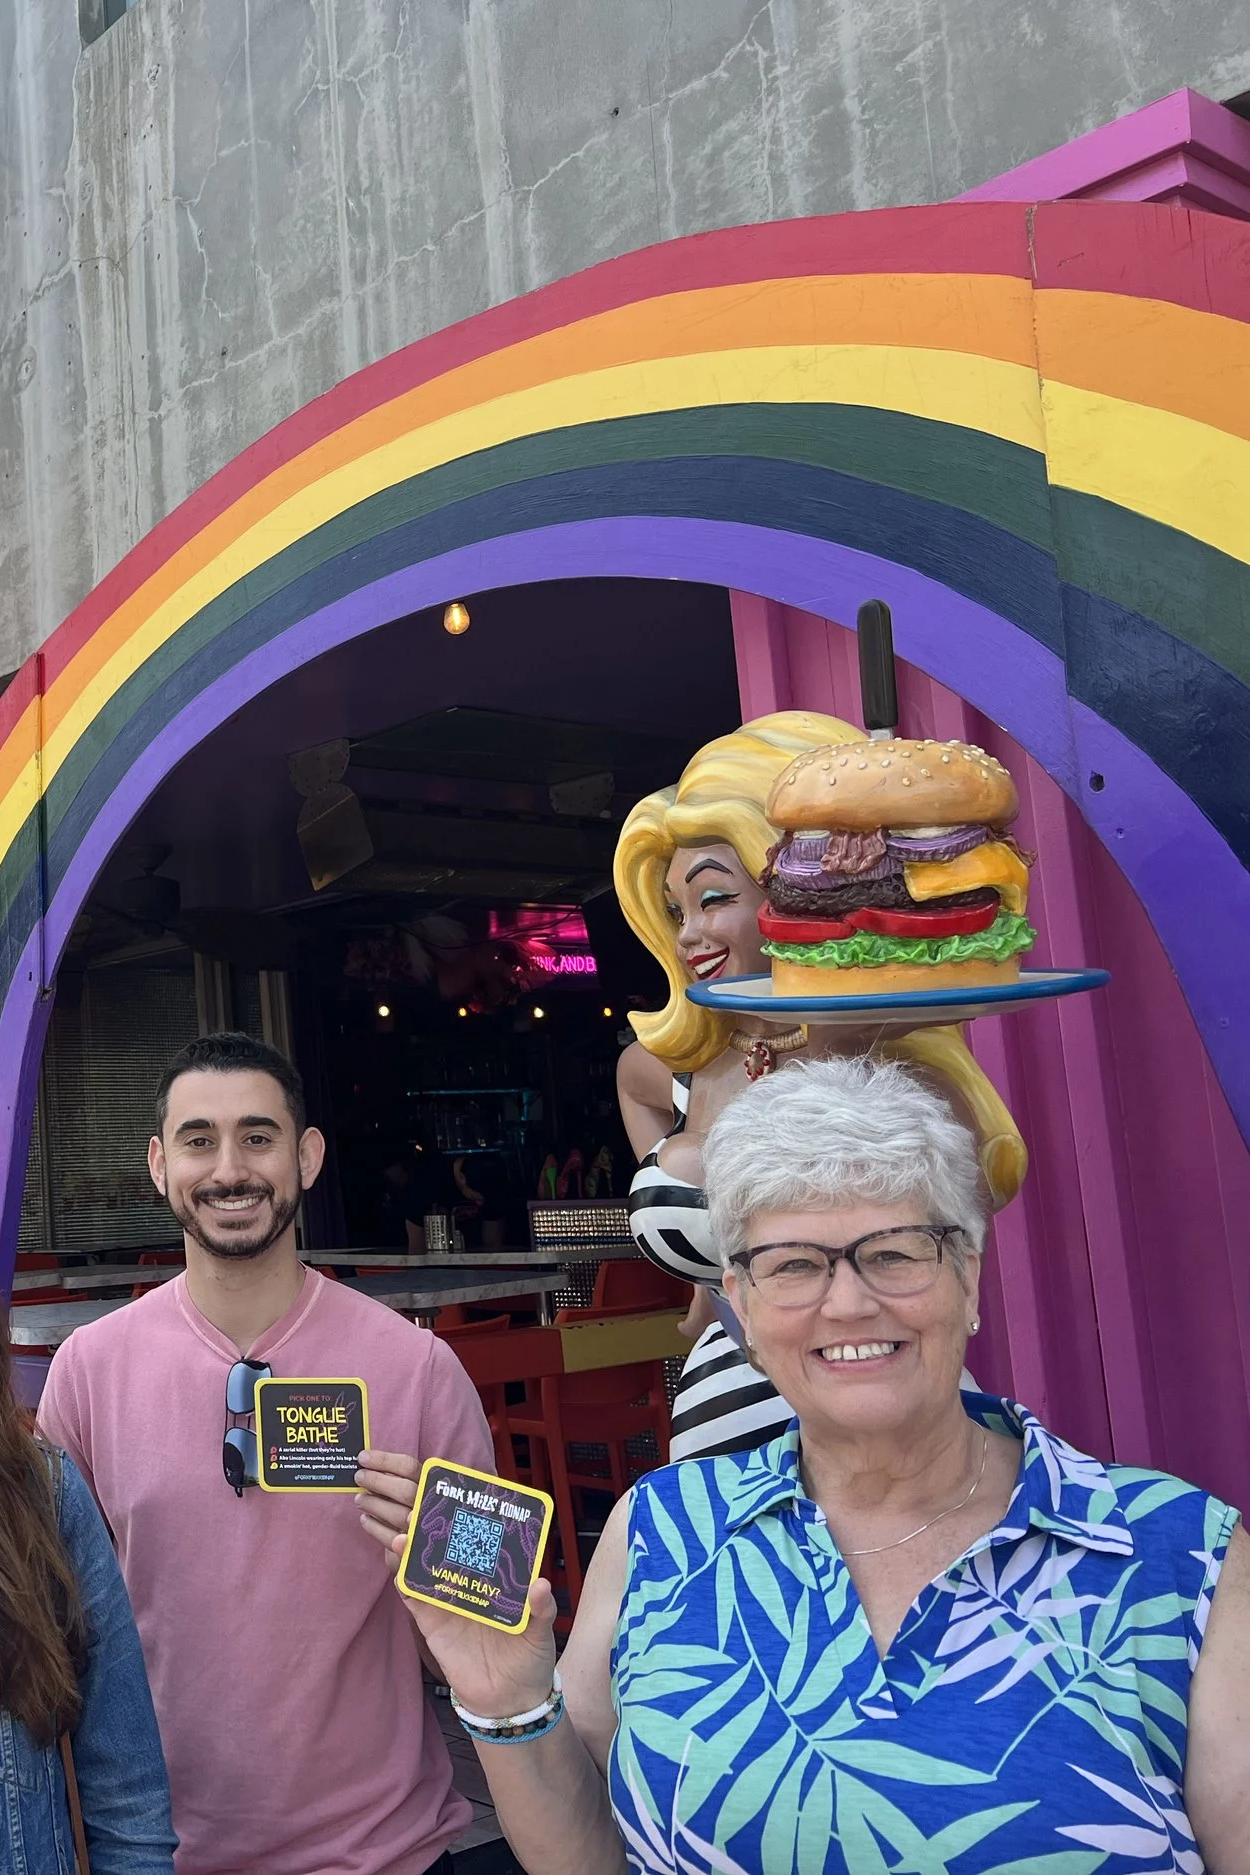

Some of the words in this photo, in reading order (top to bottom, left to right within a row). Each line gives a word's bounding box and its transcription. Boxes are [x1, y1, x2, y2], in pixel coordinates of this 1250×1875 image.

[560, 955, 585, 971] AND
[276, 1406, 346, 1423] TONGUE
[286, 1426, 339, 1443] BATHE
[499, 1501, 531, 1523] KIDNAP
[431, 1565, 468, 1588] WANNA
[471, 1578, 501, 1599] PLAY?
